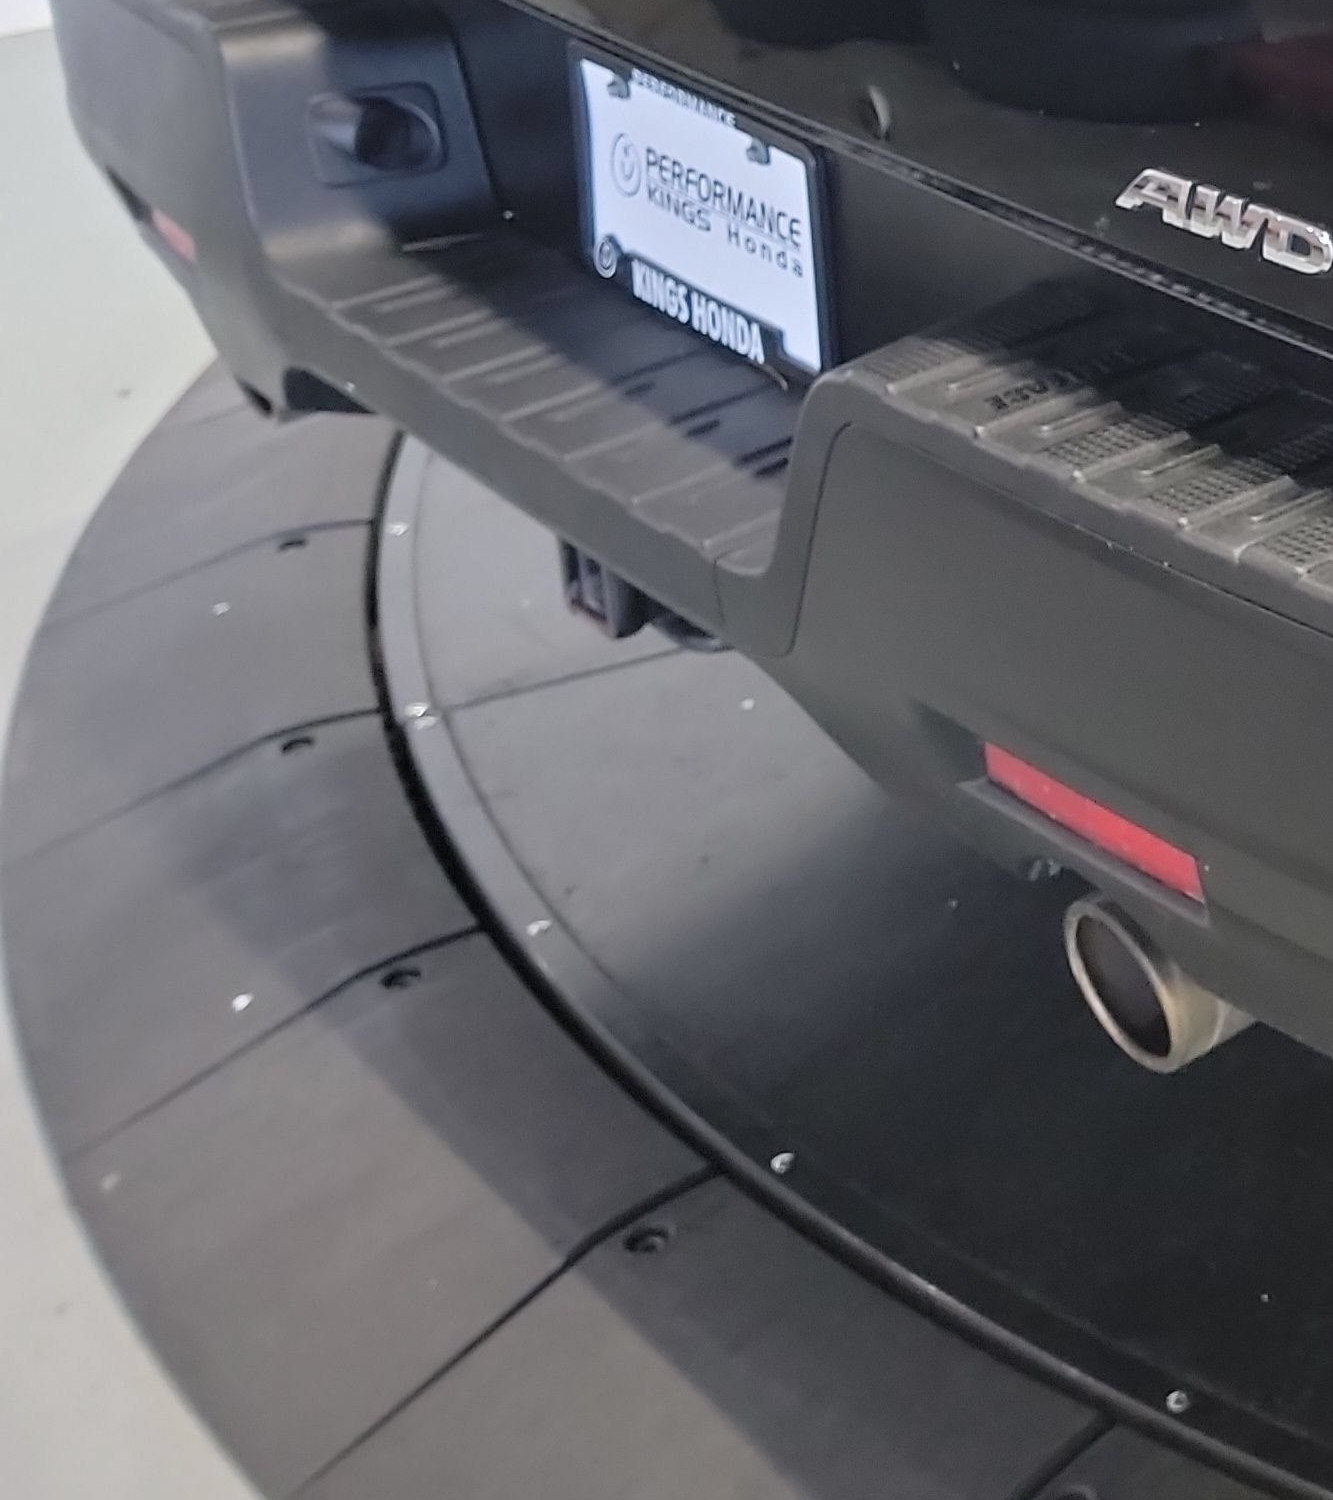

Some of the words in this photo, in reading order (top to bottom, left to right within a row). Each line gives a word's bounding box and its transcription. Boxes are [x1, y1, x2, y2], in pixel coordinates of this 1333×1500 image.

[646, 148, 801, 248] PERFORMANCE
[648, 184, 712, 232] KINGS
[727, 222, 803, 278] Honda
[631, 260, 690, 324] KINGS
[692, 291, 765, 365] HONDA
